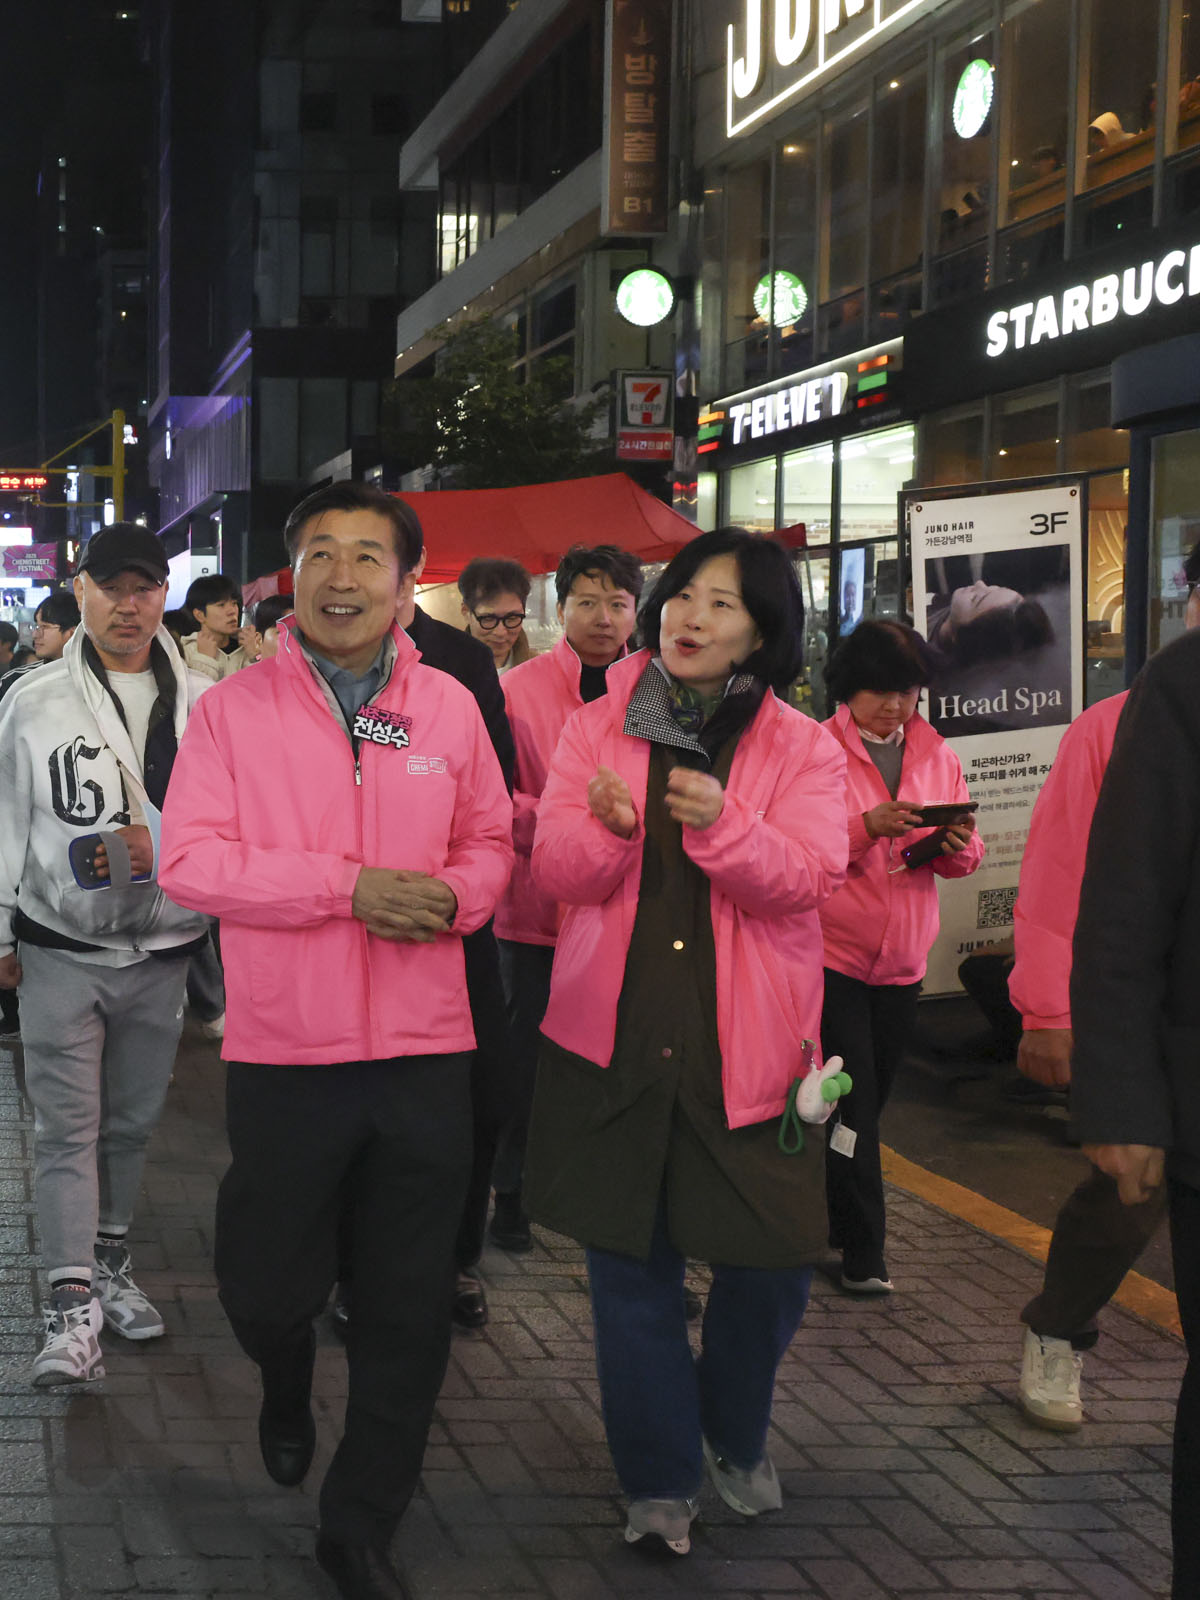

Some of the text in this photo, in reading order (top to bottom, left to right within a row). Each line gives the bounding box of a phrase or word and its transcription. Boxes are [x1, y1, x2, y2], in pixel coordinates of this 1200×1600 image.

[624, 197, 653, 213] B1
[924, 521, 975, 534] JUNO HAIR
[1029, 511, 1069, 536] 3F
[925, 533, 973, 547] 가든강남역점
[938, 687, 1063, 720] Head Spa
[353, 715, 410, 749] 전성수
[971, 753, 1031, 768] 피곤하신가요?
[980, 769, 1007, 781] 두피를
[1008, 766, 1027, 778] 쉬게
[1028, 765, 1038, 775] 해
